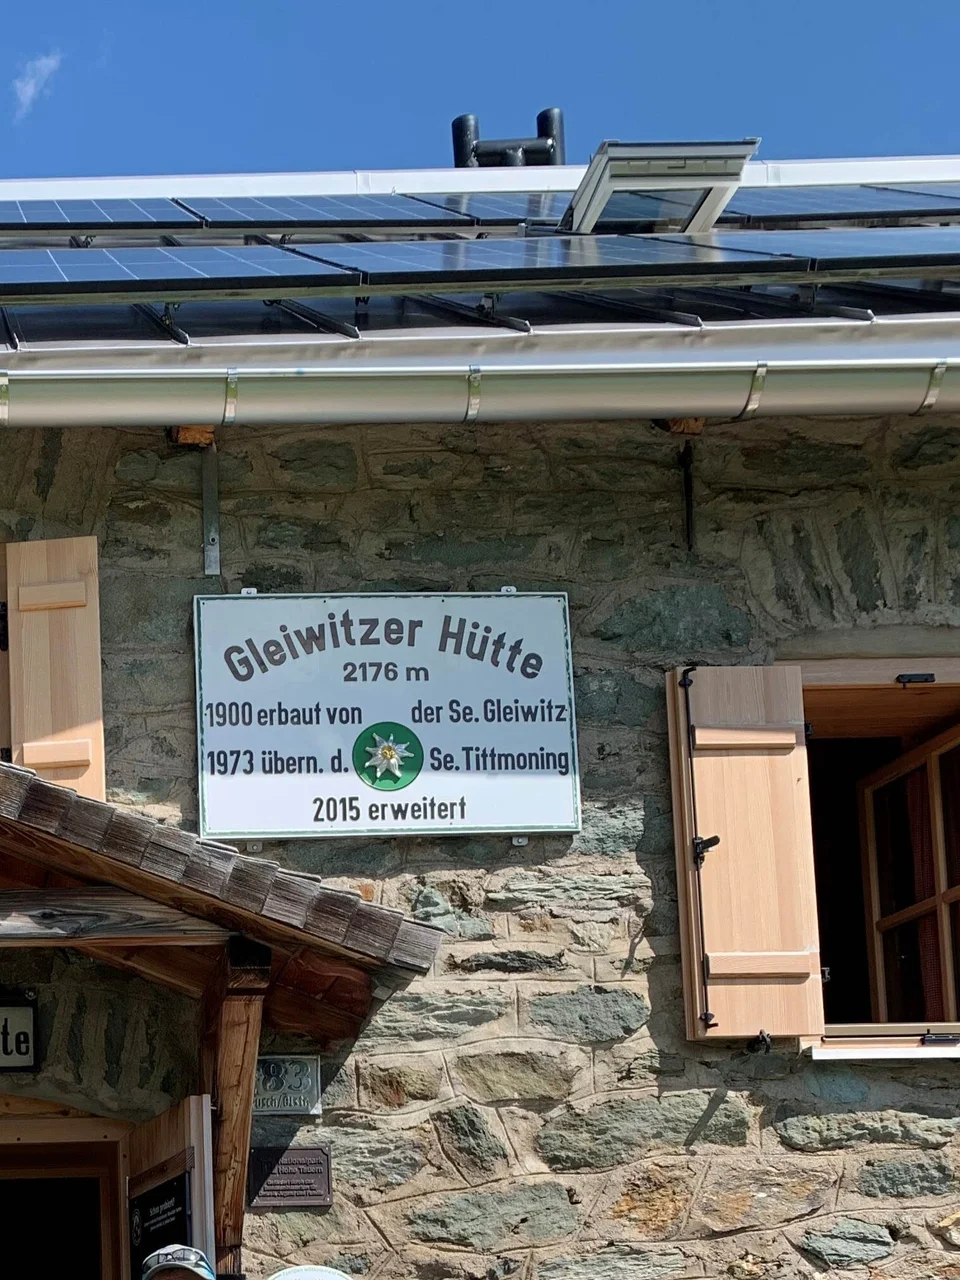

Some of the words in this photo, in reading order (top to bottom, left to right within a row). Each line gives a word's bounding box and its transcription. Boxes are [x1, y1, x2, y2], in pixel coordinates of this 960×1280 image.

[223, 609, 423, 683] Gleiwitzer
[438, 614, 544, 680] Hütte
[342, 661, 399, 682] 2176
[405, 664, 430, 682] m
[206, 701, 253, 727] 1900
[256, 702, 322, 726] erbaut
[327, 705, 362, 725] von
[411, 699, 444, 724] der
[483, 698, 568, 723] Gleiwitz
[207, 749, 254, 775] 1973
[261, 749, 324, 774] übern.
[330, 748, 349, 774] d.
[312, 797, 361, 823] 2015
[368, 796, 467, 821] erweitert
